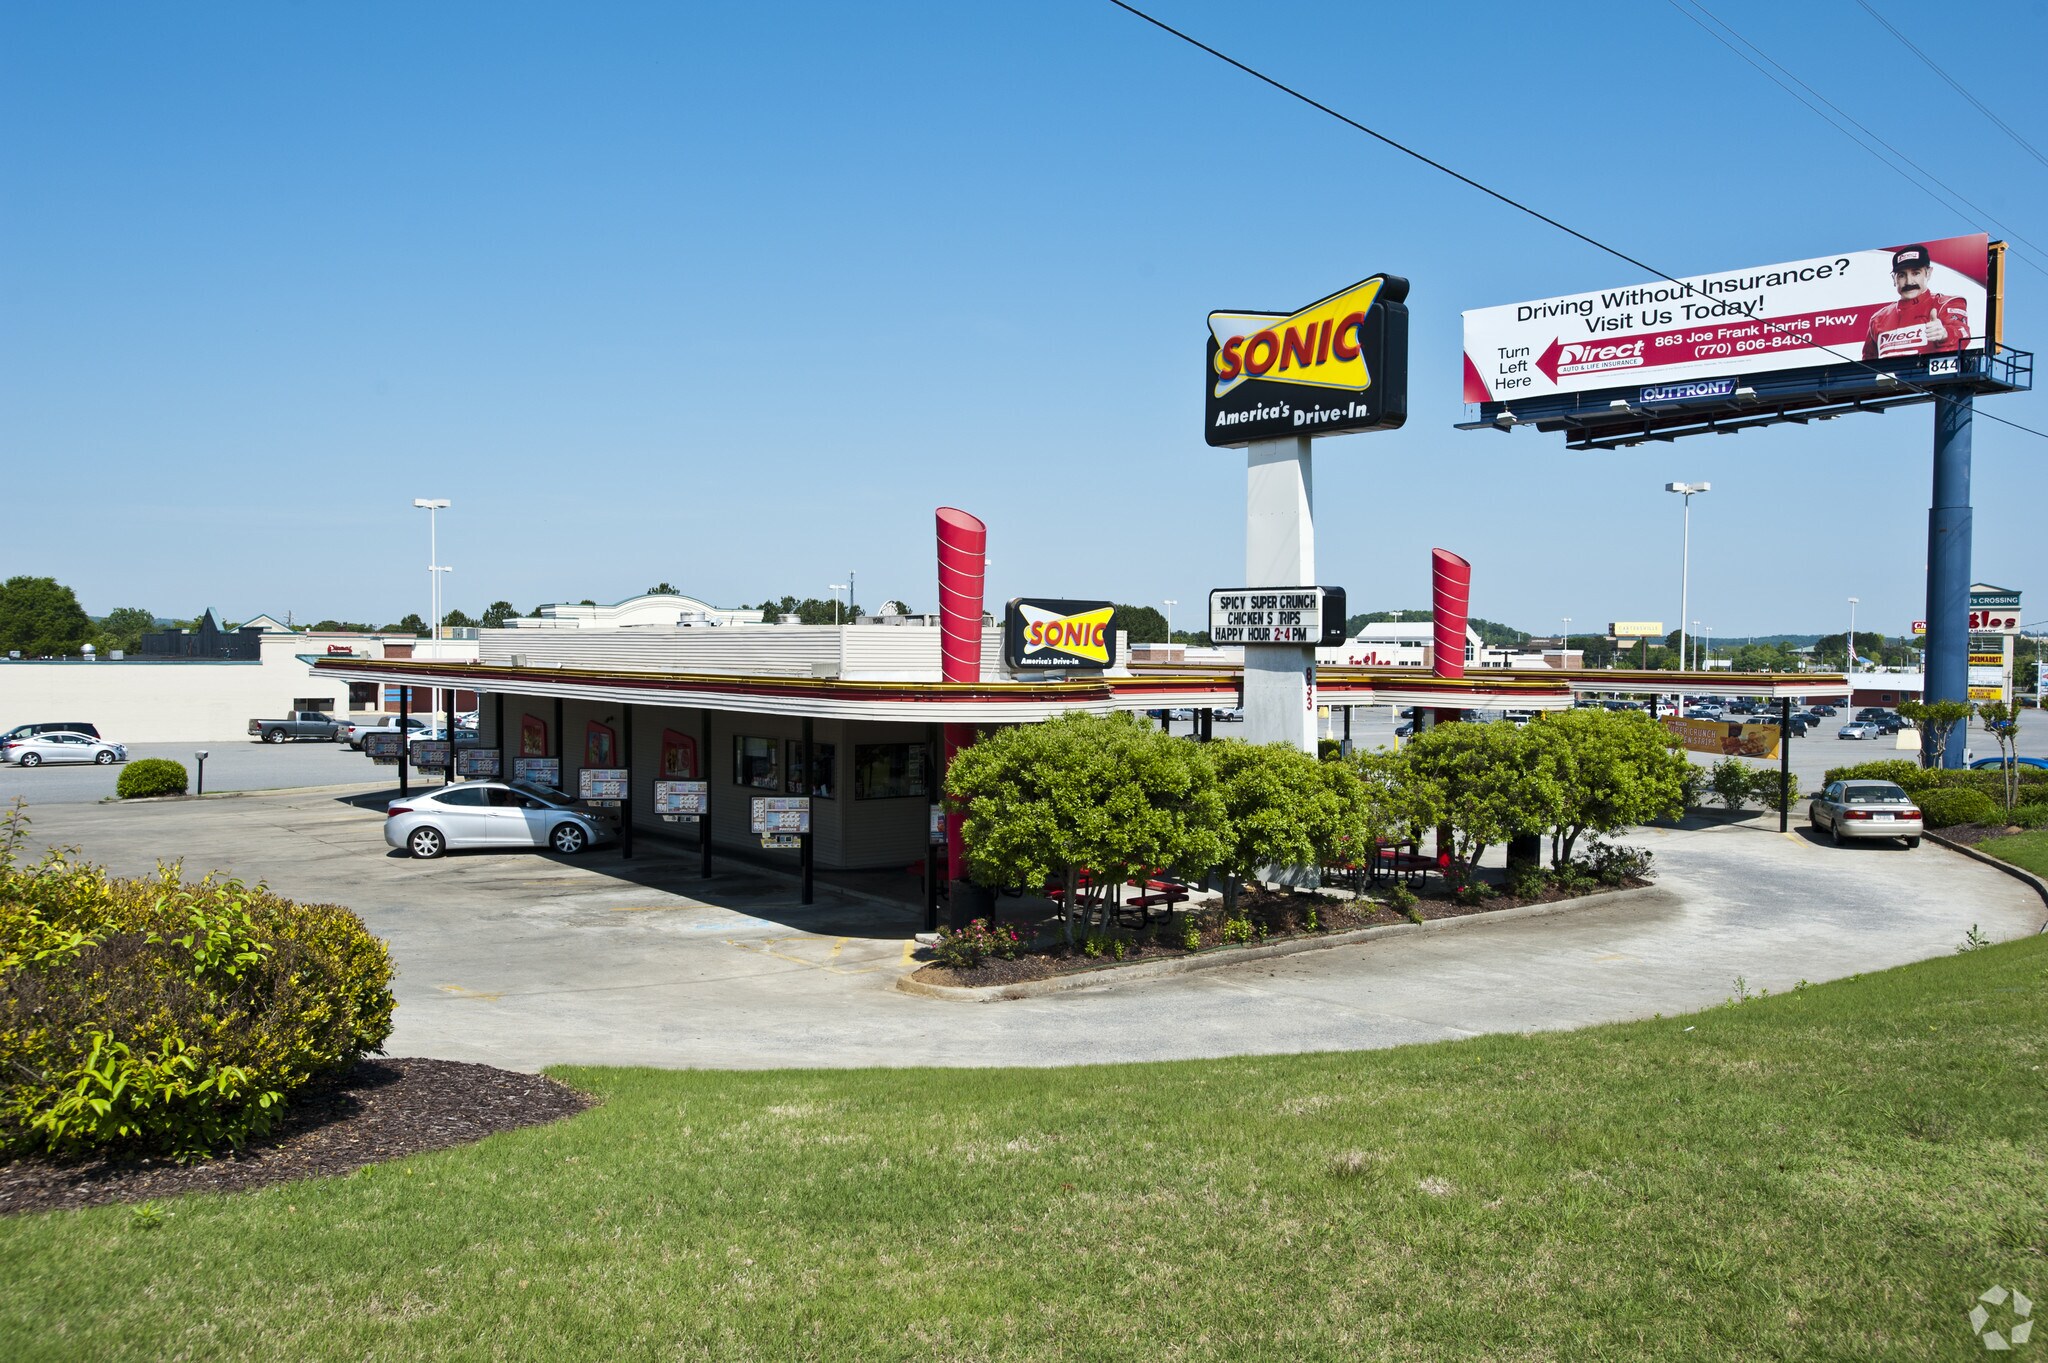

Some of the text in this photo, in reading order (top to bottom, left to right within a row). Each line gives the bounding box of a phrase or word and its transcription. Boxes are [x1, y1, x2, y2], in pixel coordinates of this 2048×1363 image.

[1517, 258, 1850, 322] Driving Without Insurance?
[1585, 295, 1764, 333] Visit Us Today!
[1655, 313, 1858, 347] 863 Joe Frank Harris Pkwy
[1880, 328, 1923, 344] Direct
[1219, 311, 1366, 382] SONIC
[1498, 347, 1530, 359] Turn
[1557, 340, 1645, 365] Direct
[1694, 333, 1812, 358] (770) 606-8400
[1499, 360, 1528, 374] Left
[1563, 364, 1579, 373] AUTO
[1586, 362, 1600, 370] LIFE
[1601, 359, 1638, 368] INSURANCE
[1495, 376, 1531, 390] Here
[1643, 380, 1732, 400] OUTFRONT
[1215, 400, 1290, 427] America's
[1220, 594, 1316, 610] SPICY SUPER CRUNCH
[1227, 611, 1264, 625] CHICKEN
[1969, 610, 2016, 629] gles
[1029, 620, 1107, 647] SONIC
[1215, 627, 1307, 641] HAPPY HOUR 2-4 PM
[1021, 657, 1052, 665] America's
[1669, 725, 1688, 736] UPER
